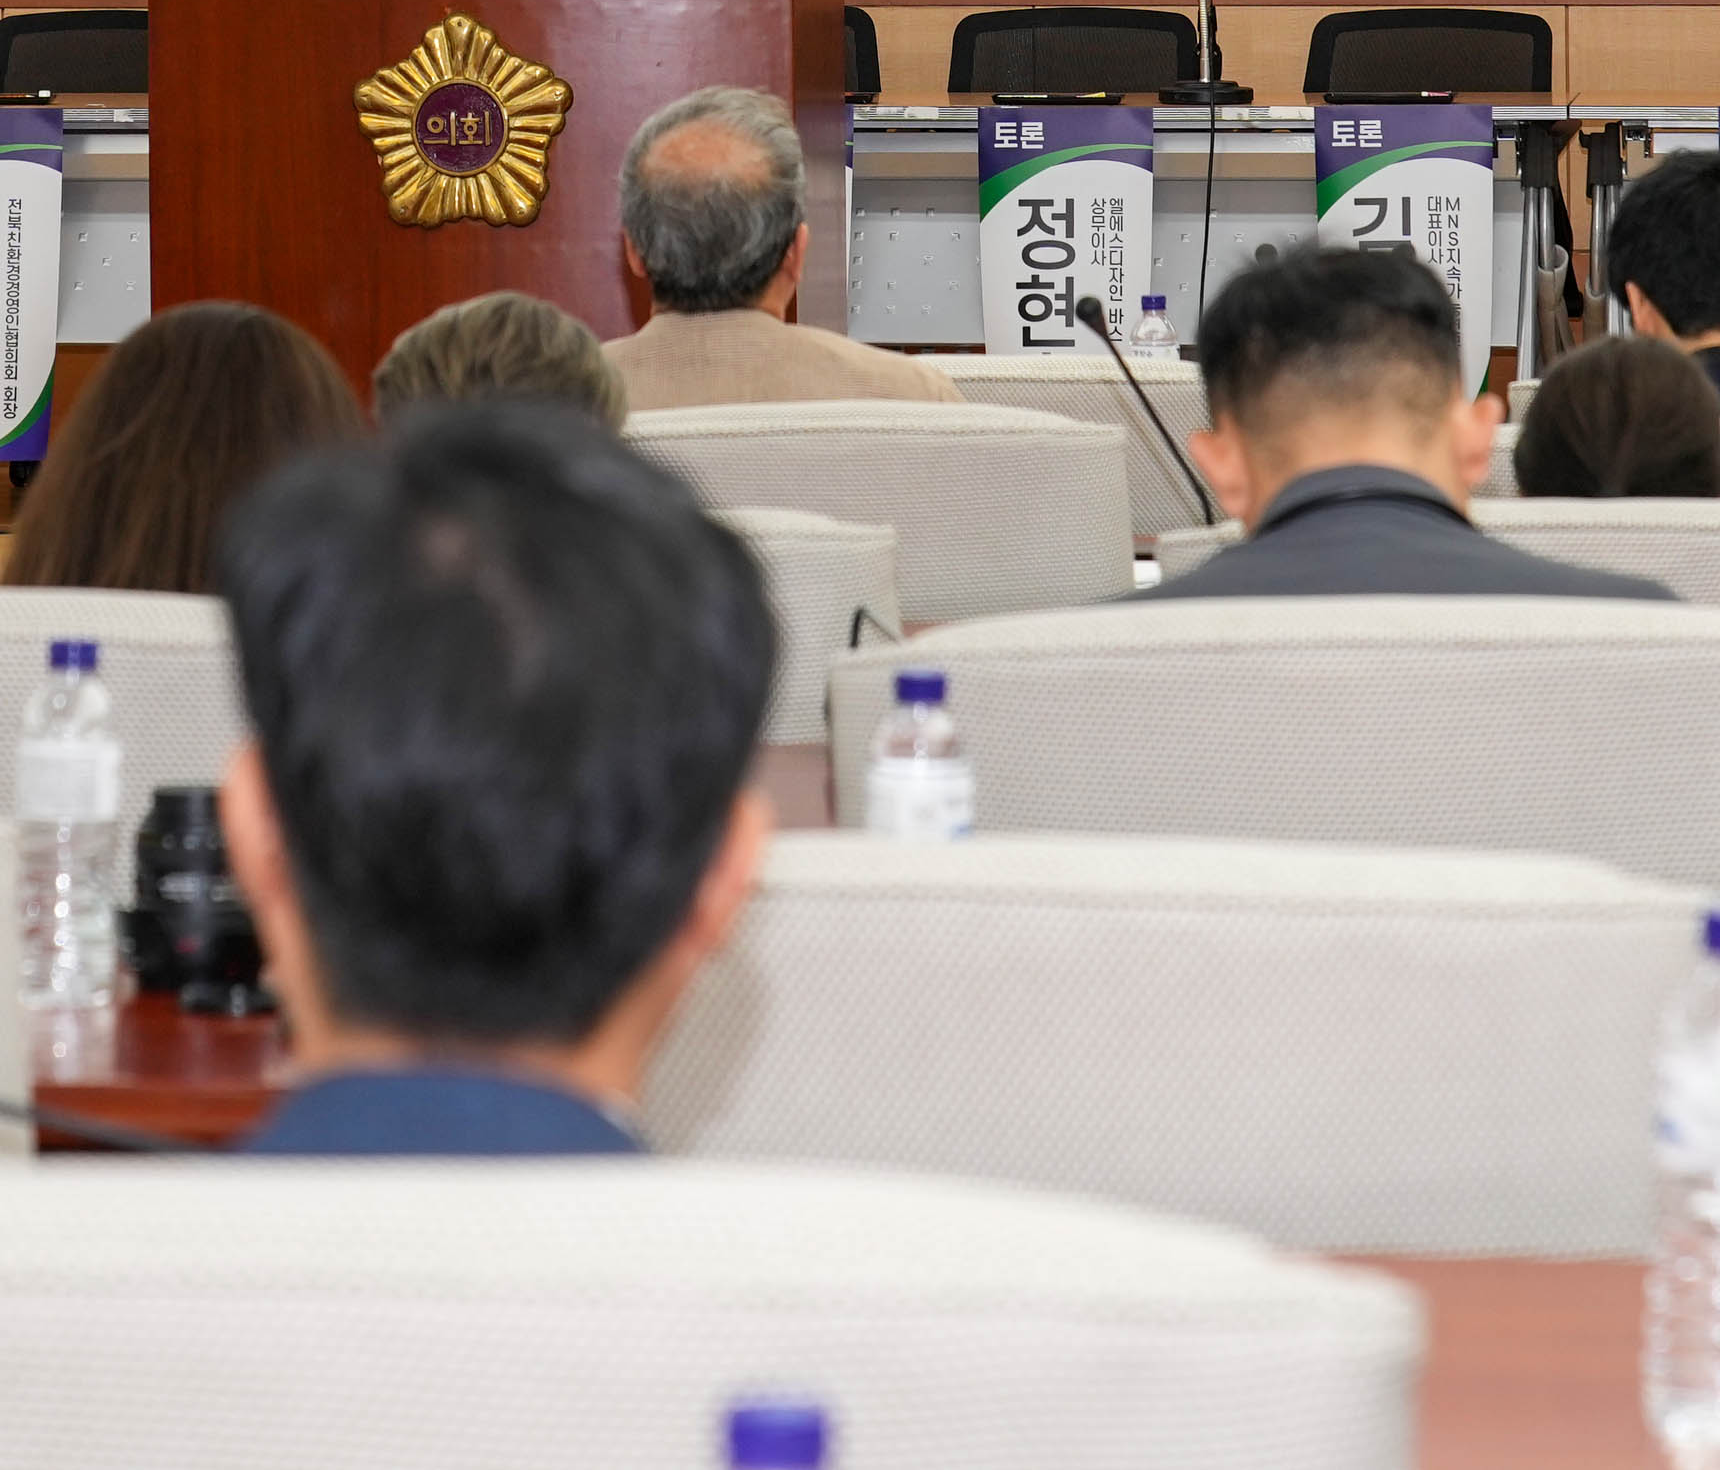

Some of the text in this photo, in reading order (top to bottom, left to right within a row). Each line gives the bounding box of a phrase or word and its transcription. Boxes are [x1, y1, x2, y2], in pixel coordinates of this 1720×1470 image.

[422, 110, 492, 147] 의회
[993, 121, 1045, 150] 토론
[1331, 119, 1383, 148] 토론
[1090, 197, 1107, 267] 상무이사
[1109, 197, 1125, 302] 엘에스디자인
[1427, 196, 1444, 265] 대표이사
[1015, 198, 1076, 354] 정현
[3, 385, 19, 420] 회장
